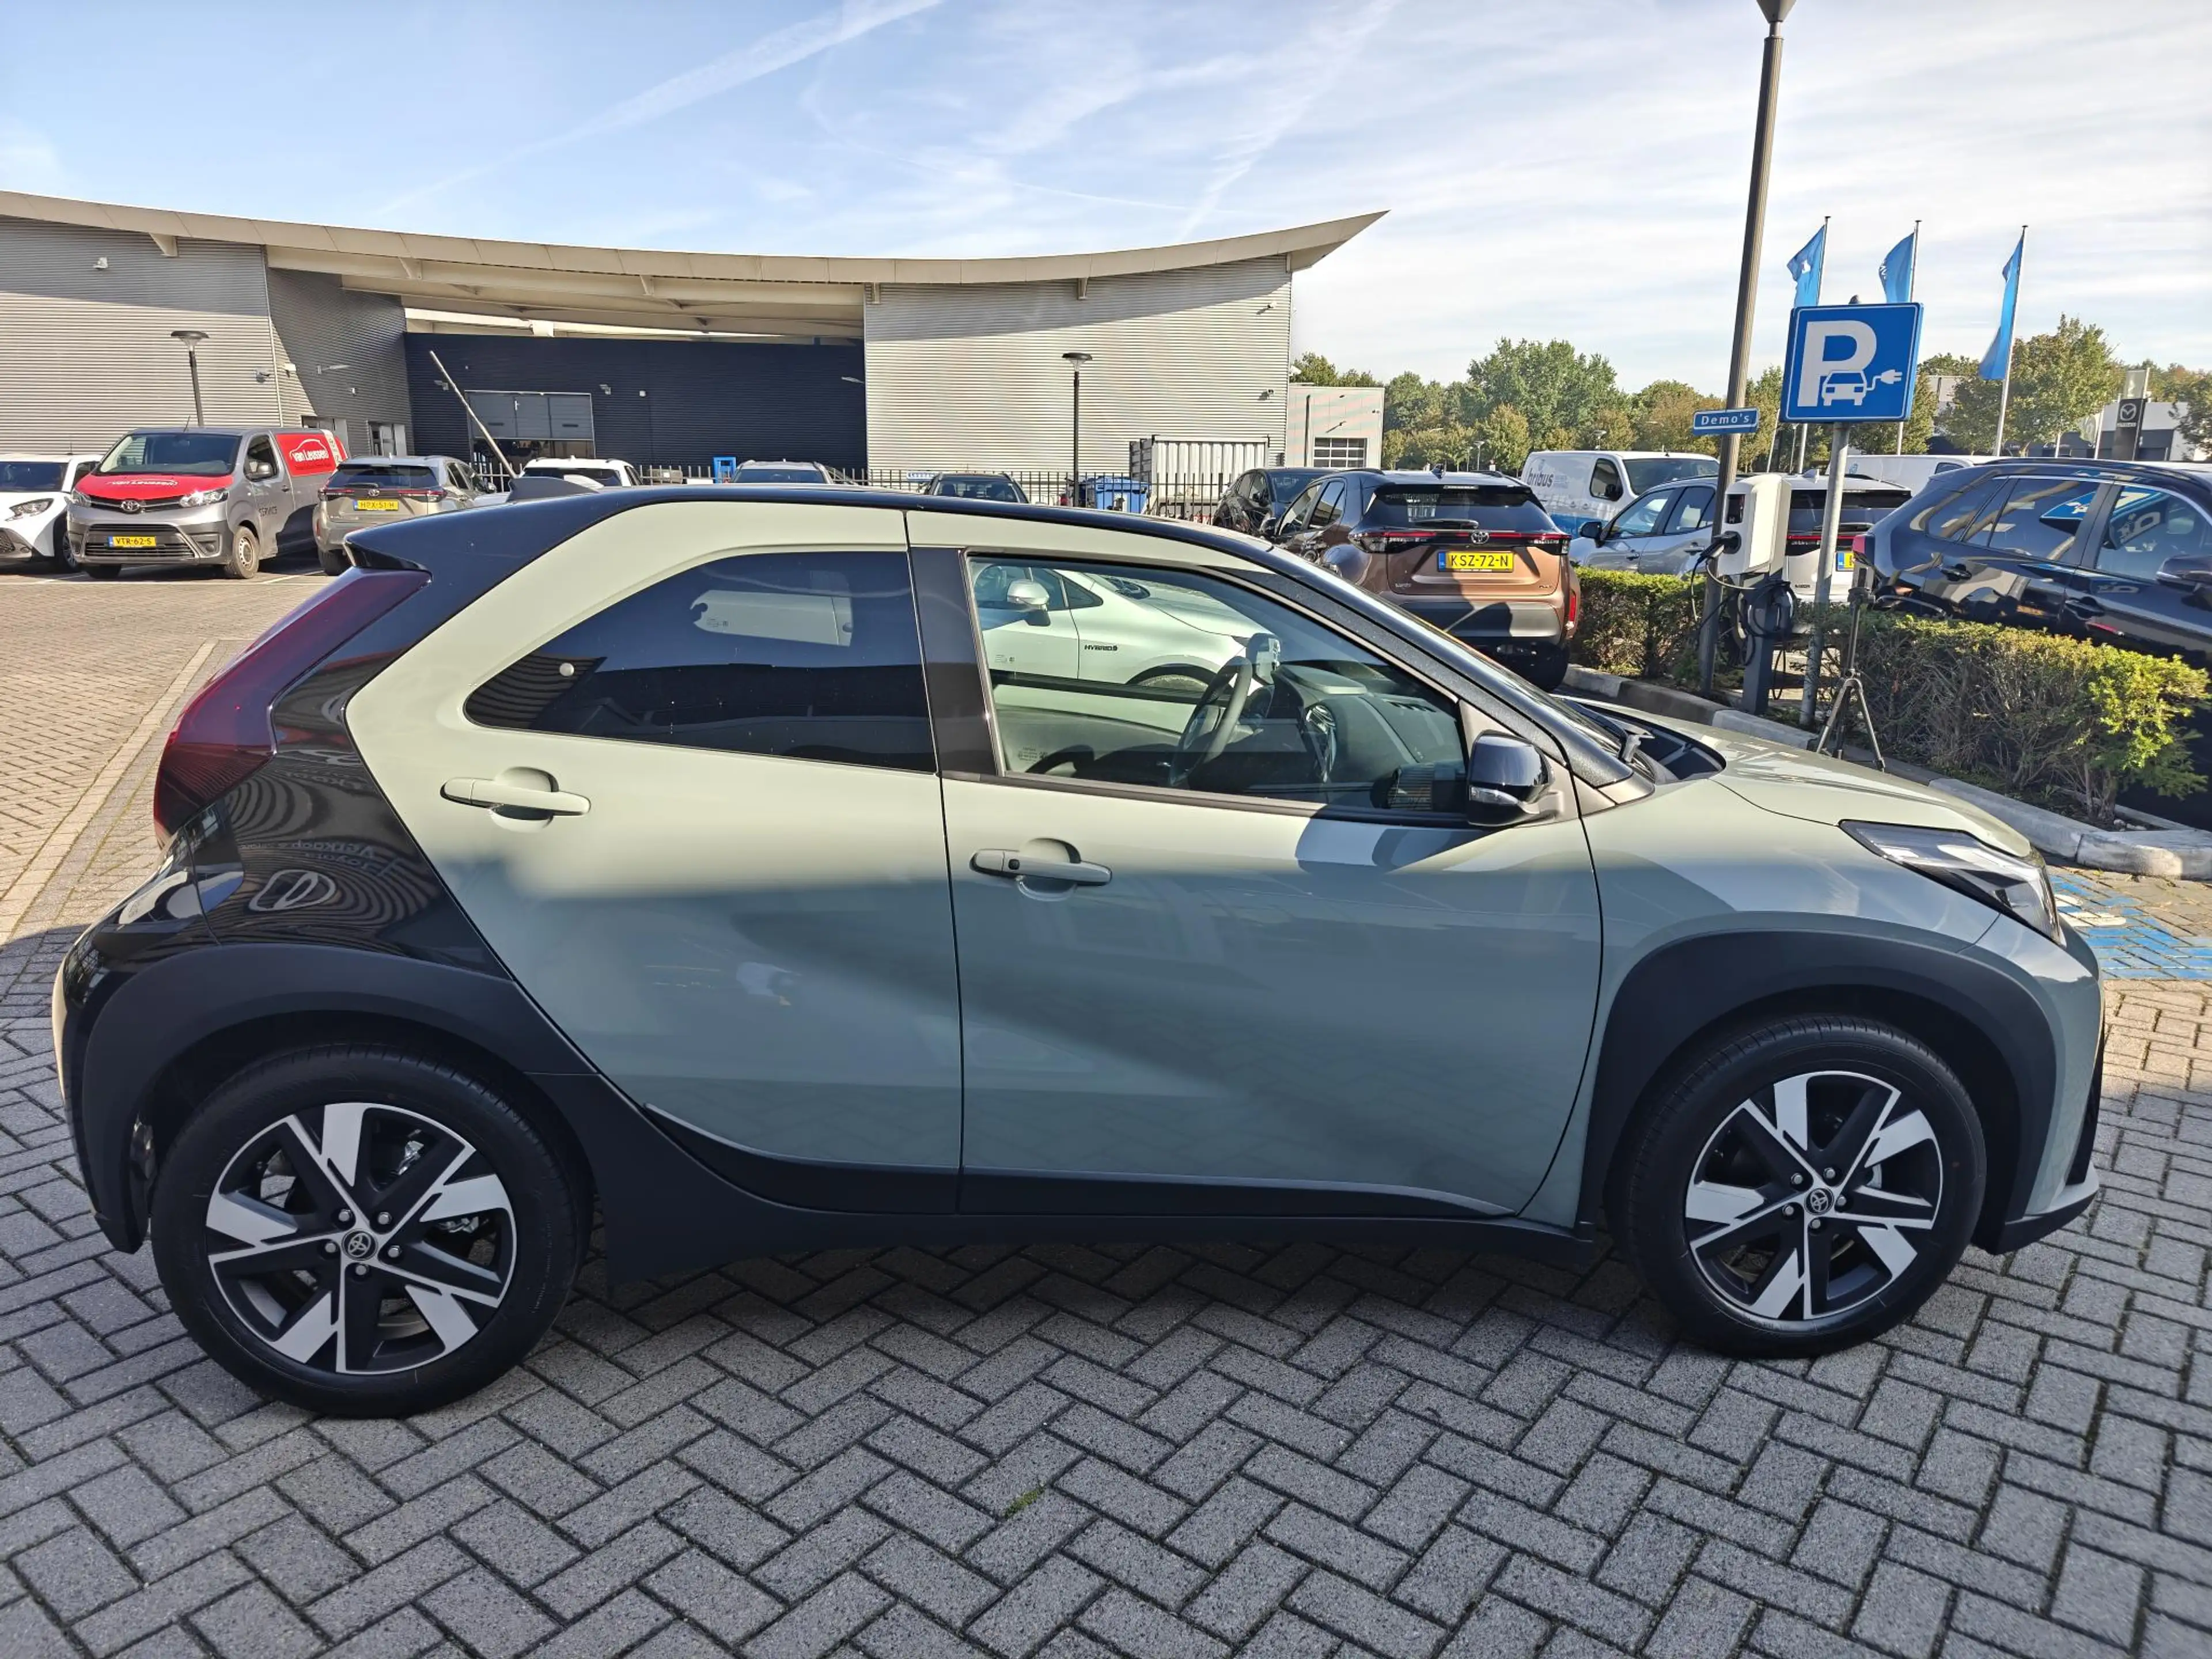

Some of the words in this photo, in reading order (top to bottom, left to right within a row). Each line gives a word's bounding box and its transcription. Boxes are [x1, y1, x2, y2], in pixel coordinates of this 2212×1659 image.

[1797, 320, 1877, 407] P
[1701, 412, 1749, 425] Demo's
[1527, 468, 1554, 488] bribus
[1450, 555, 1509, 567] KSZ-72-N
